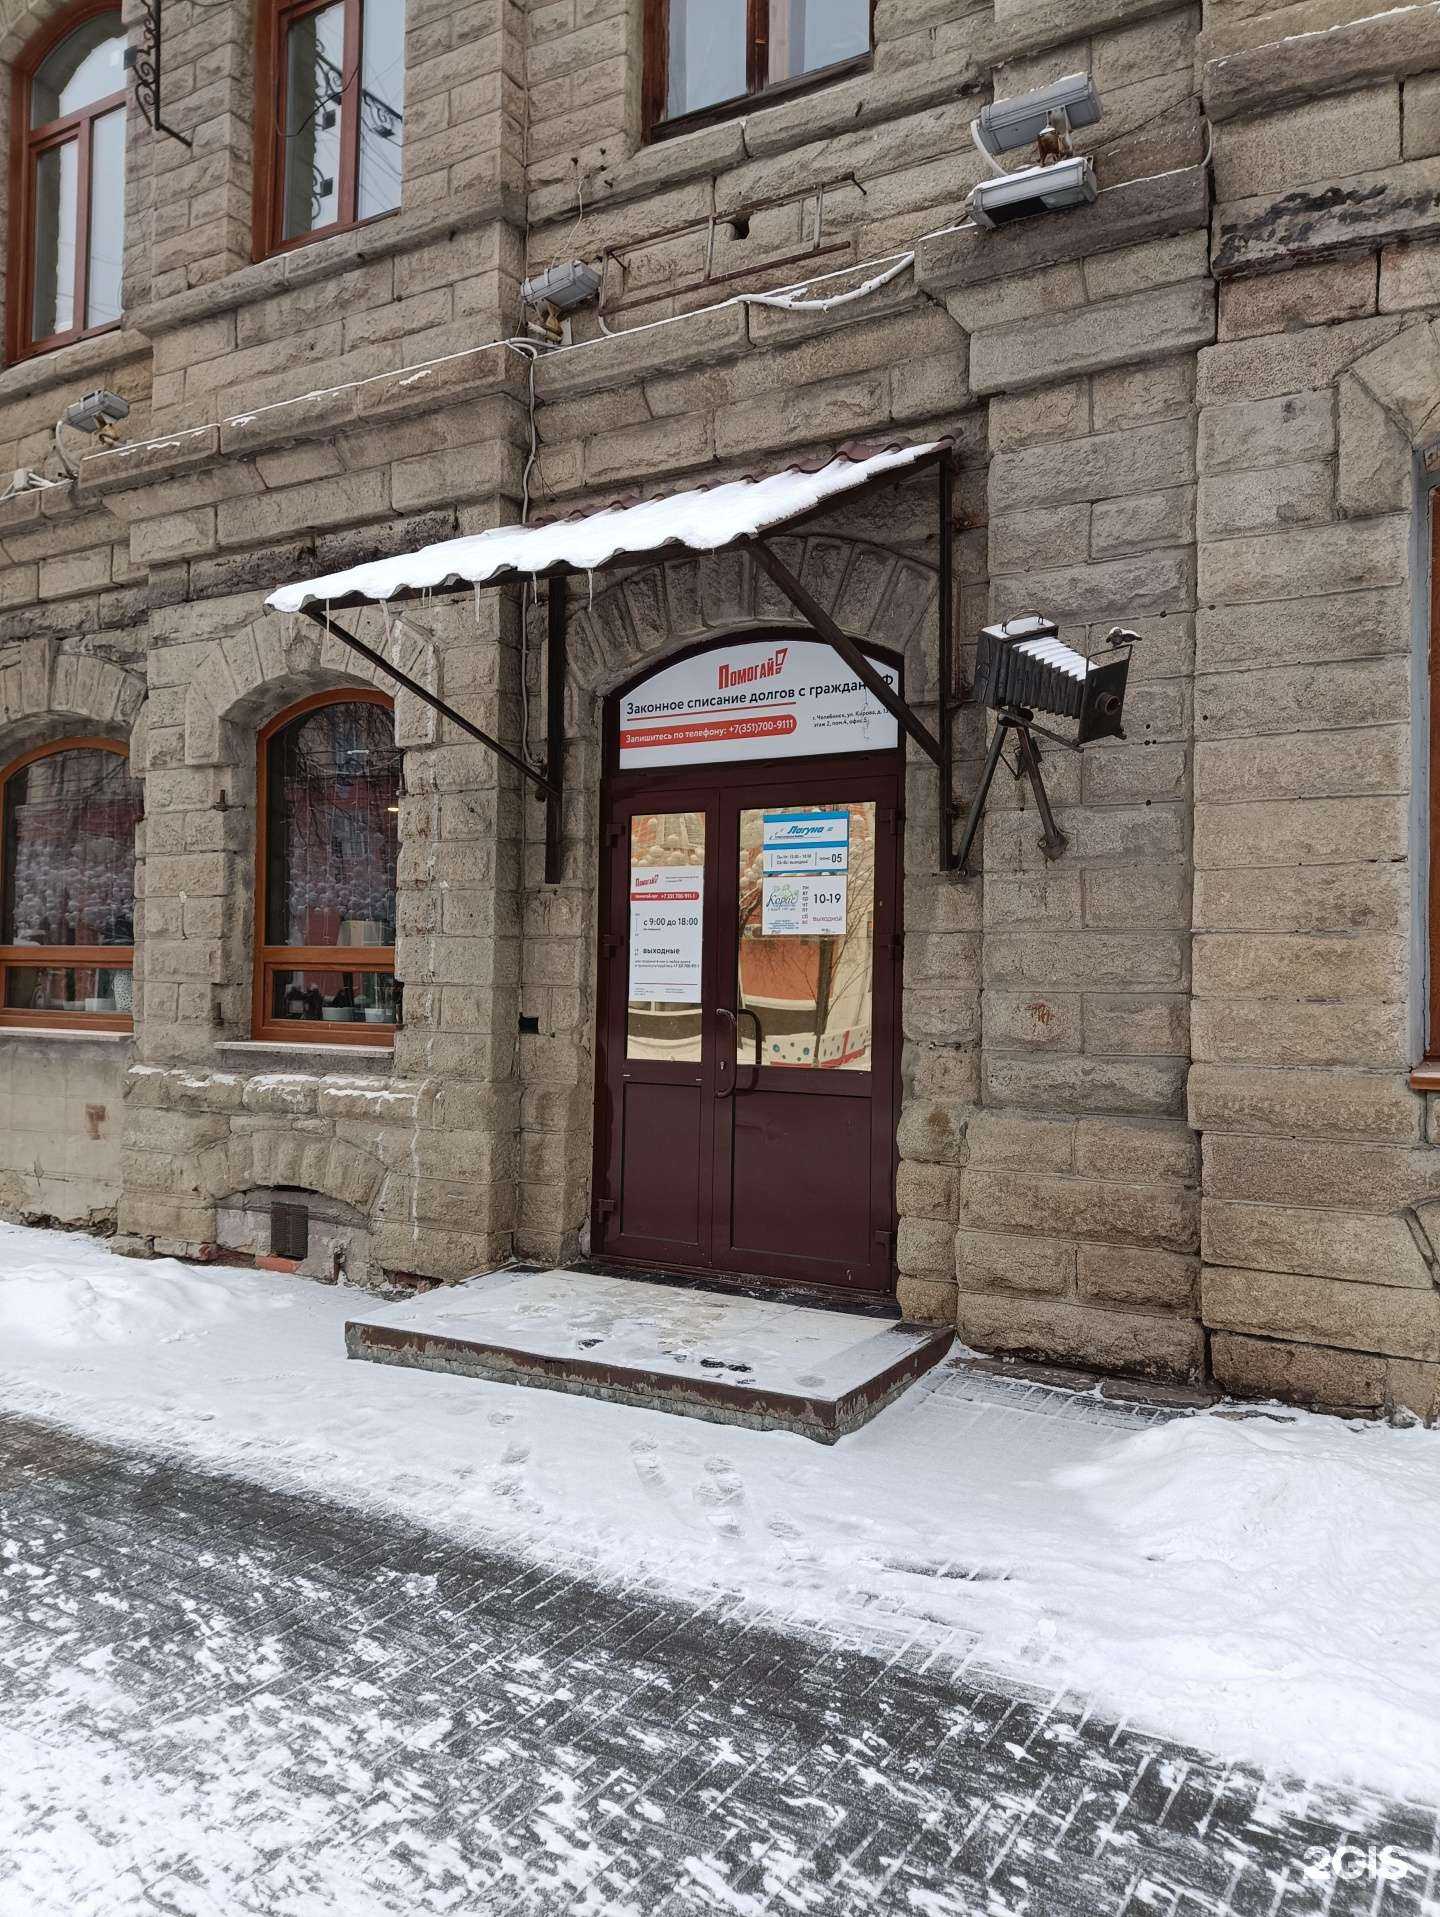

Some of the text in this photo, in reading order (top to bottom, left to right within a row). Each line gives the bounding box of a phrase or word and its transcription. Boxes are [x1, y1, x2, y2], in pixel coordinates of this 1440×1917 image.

[626, 701, 685, 715] Законное
[687, 694, 747, 709] списание
[749, 688, 795, 703] долгов
[798, 687, 806, 697] с
[625, 718, 794, 744] Запишитесь по телефону: +7(351)700-9111
[787, 825, 825, 836] Лагуна
[831, 853, 843, 863] 05
[813, 893, 842, 904] 10-19
[648, 917, 666, 927] 9:00
[666, 919, 677, 927] до
[678, 916, 699, 927] 18:00
[642, 948, 681, 956] выходные
